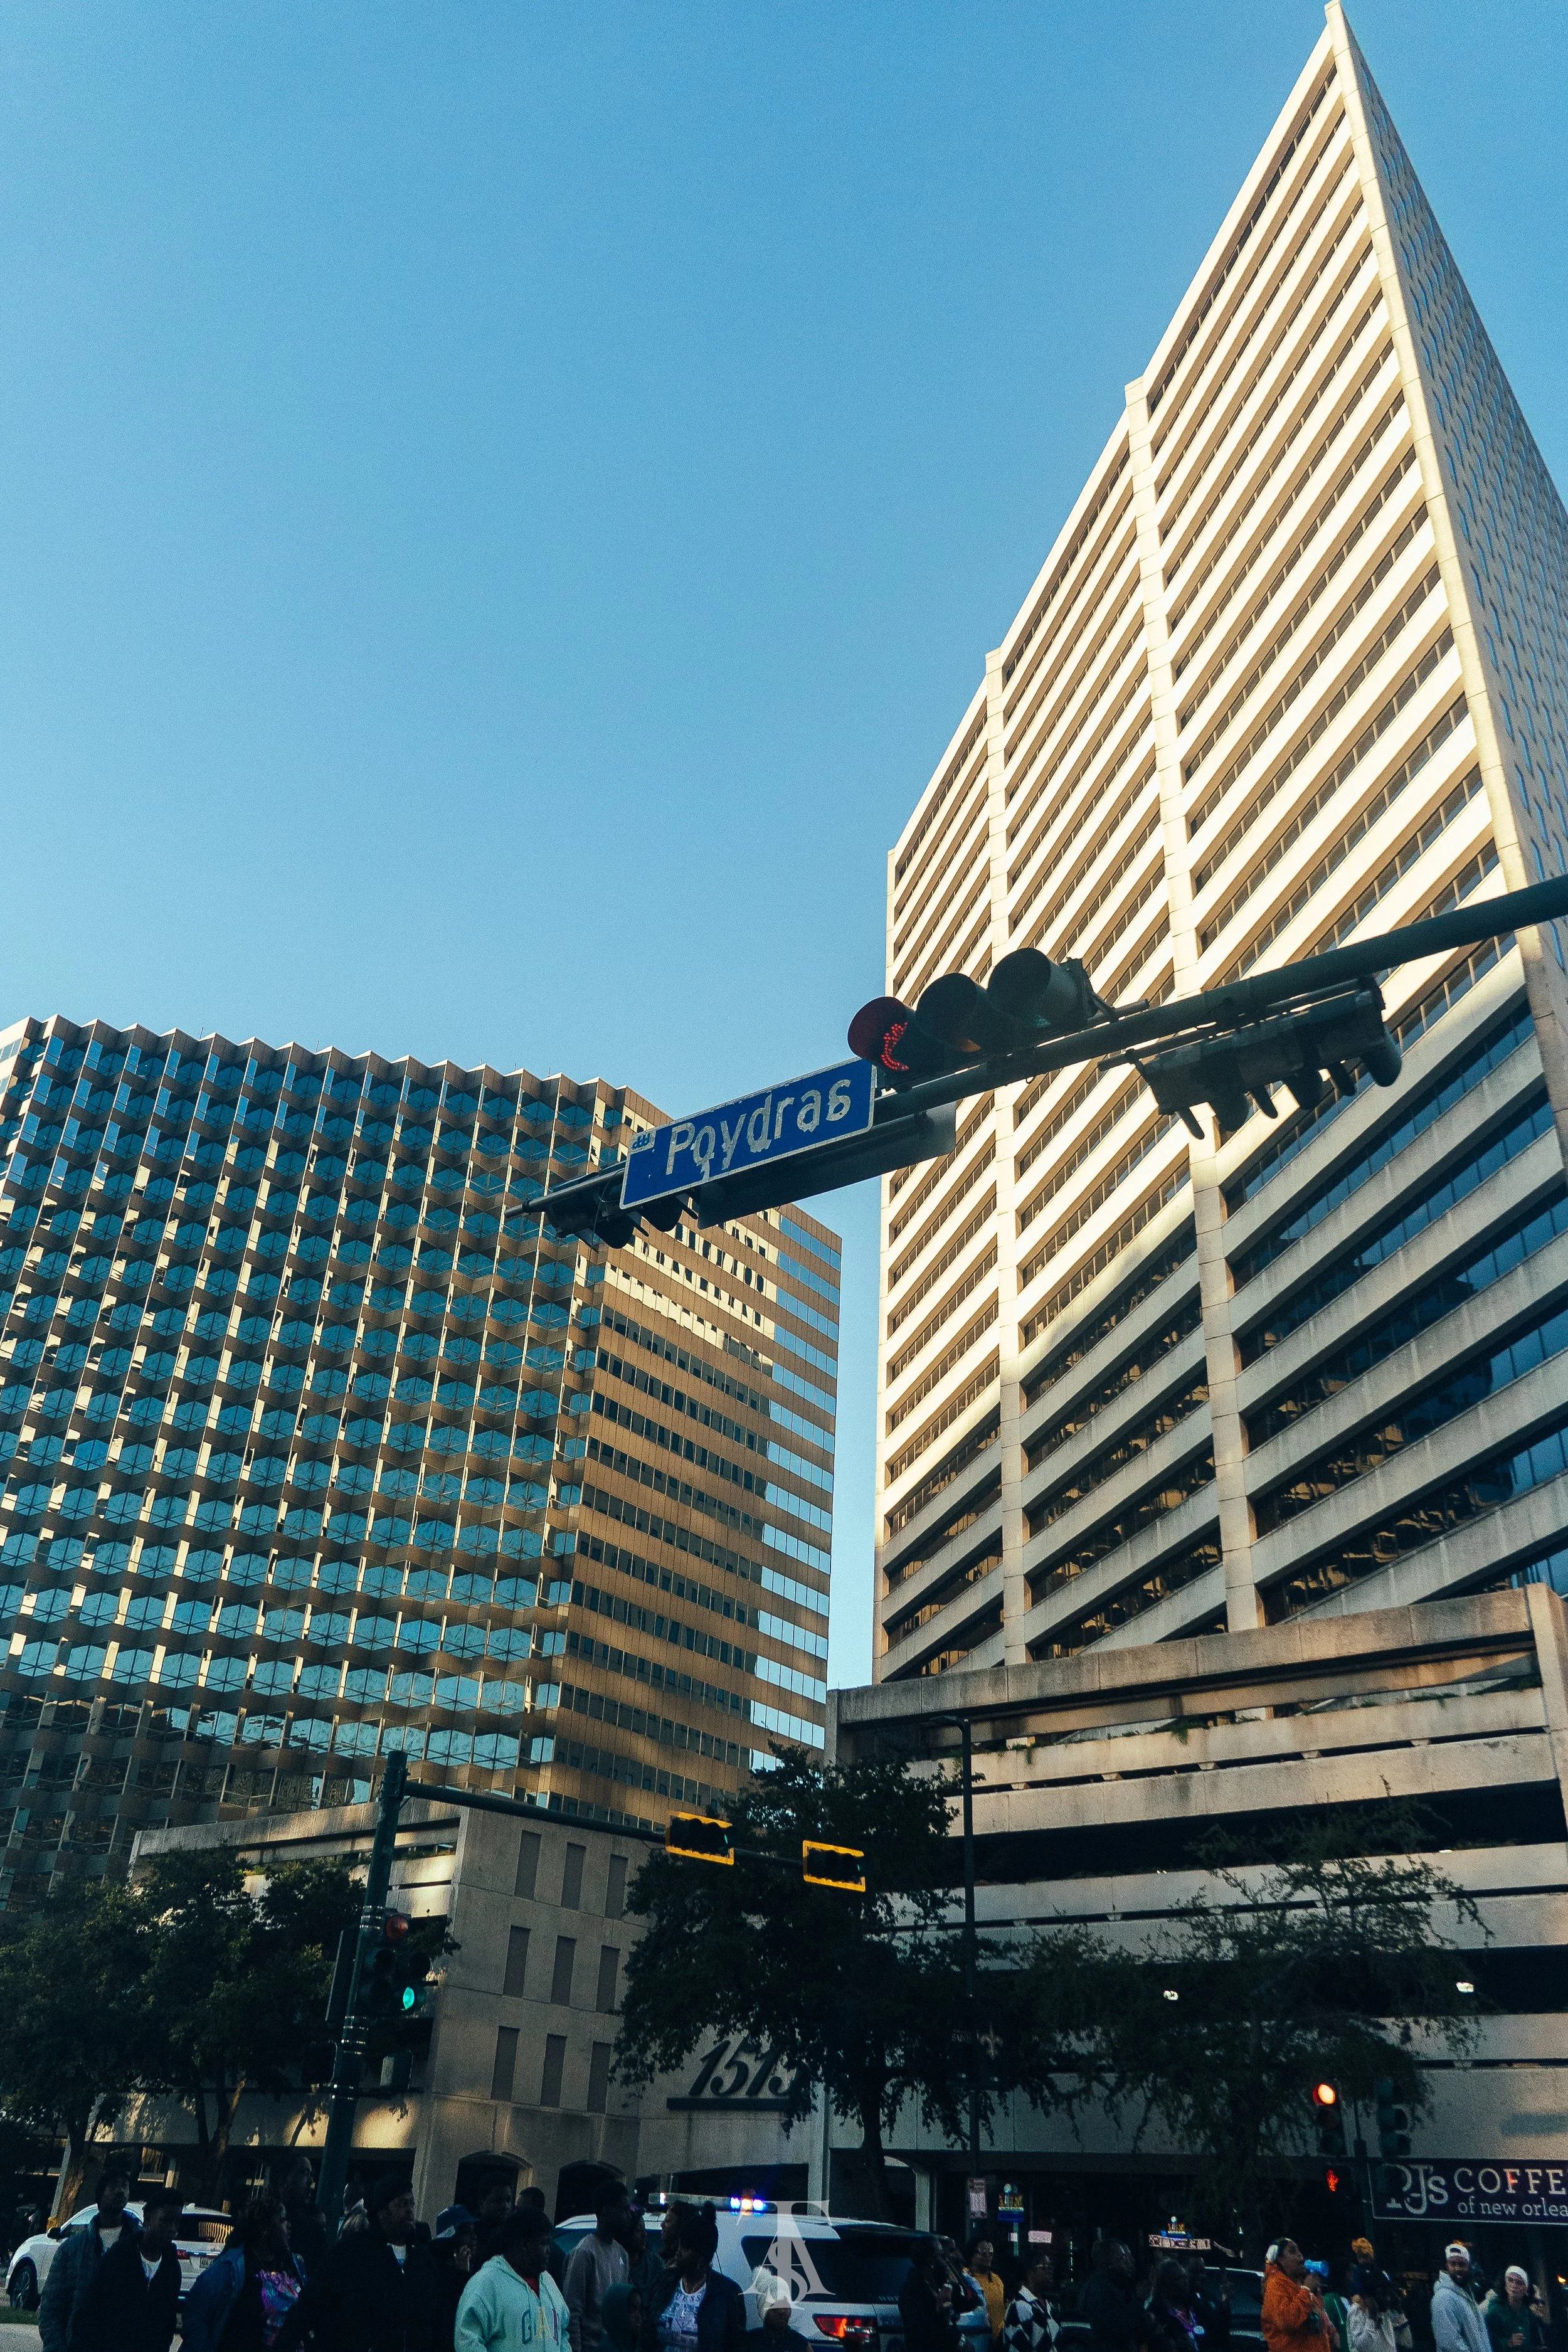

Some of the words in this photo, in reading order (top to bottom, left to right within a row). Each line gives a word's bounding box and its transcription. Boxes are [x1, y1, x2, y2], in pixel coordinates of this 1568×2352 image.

[665, 1079, 852, 1175] Poydras
[1454, 2167, 1568, 2195] COFFE
[1458, 2196, 1476, 2214] of
[1480, 2203, 1517, 2215] new
